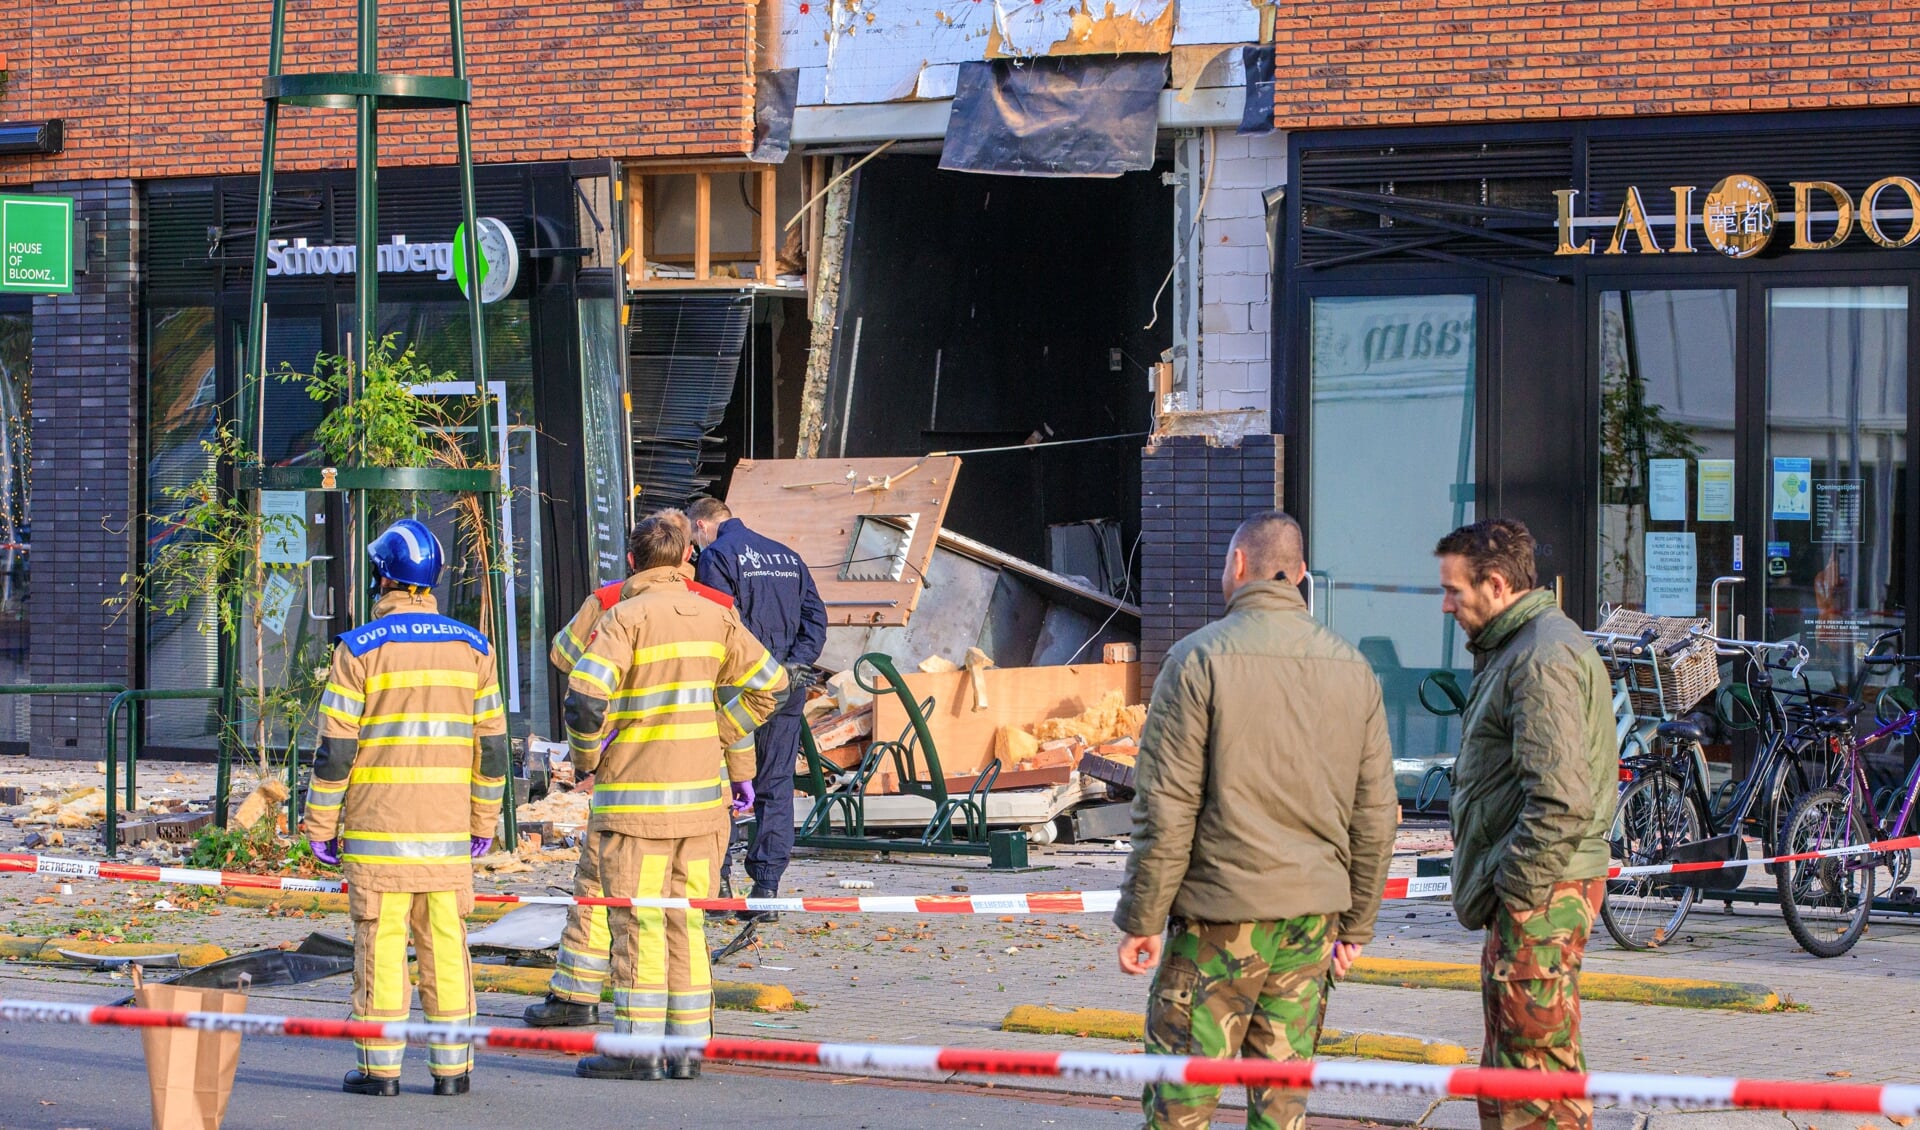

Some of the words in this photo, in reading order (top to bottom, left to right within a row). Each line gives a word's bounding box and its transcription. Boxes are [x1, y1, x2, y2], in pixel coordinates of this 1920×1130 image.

[1552, 186, 1697, 256] LAI
[9, 242, 43, 255] HOUSE
[9, 255, 23, 267] OF
[267, 234, 456, 281] Schoonnberg
[9, 268, 56, 281] BLOOMZ.
[1816, 484, 1860, 492] Openingstijden
[356, 626, 388, 646] OVD
[390, 624, 408, 635] IN
[411, 623, 484, 646] OPLEIDING
[39, 860, 84, 875] BETREDEN
